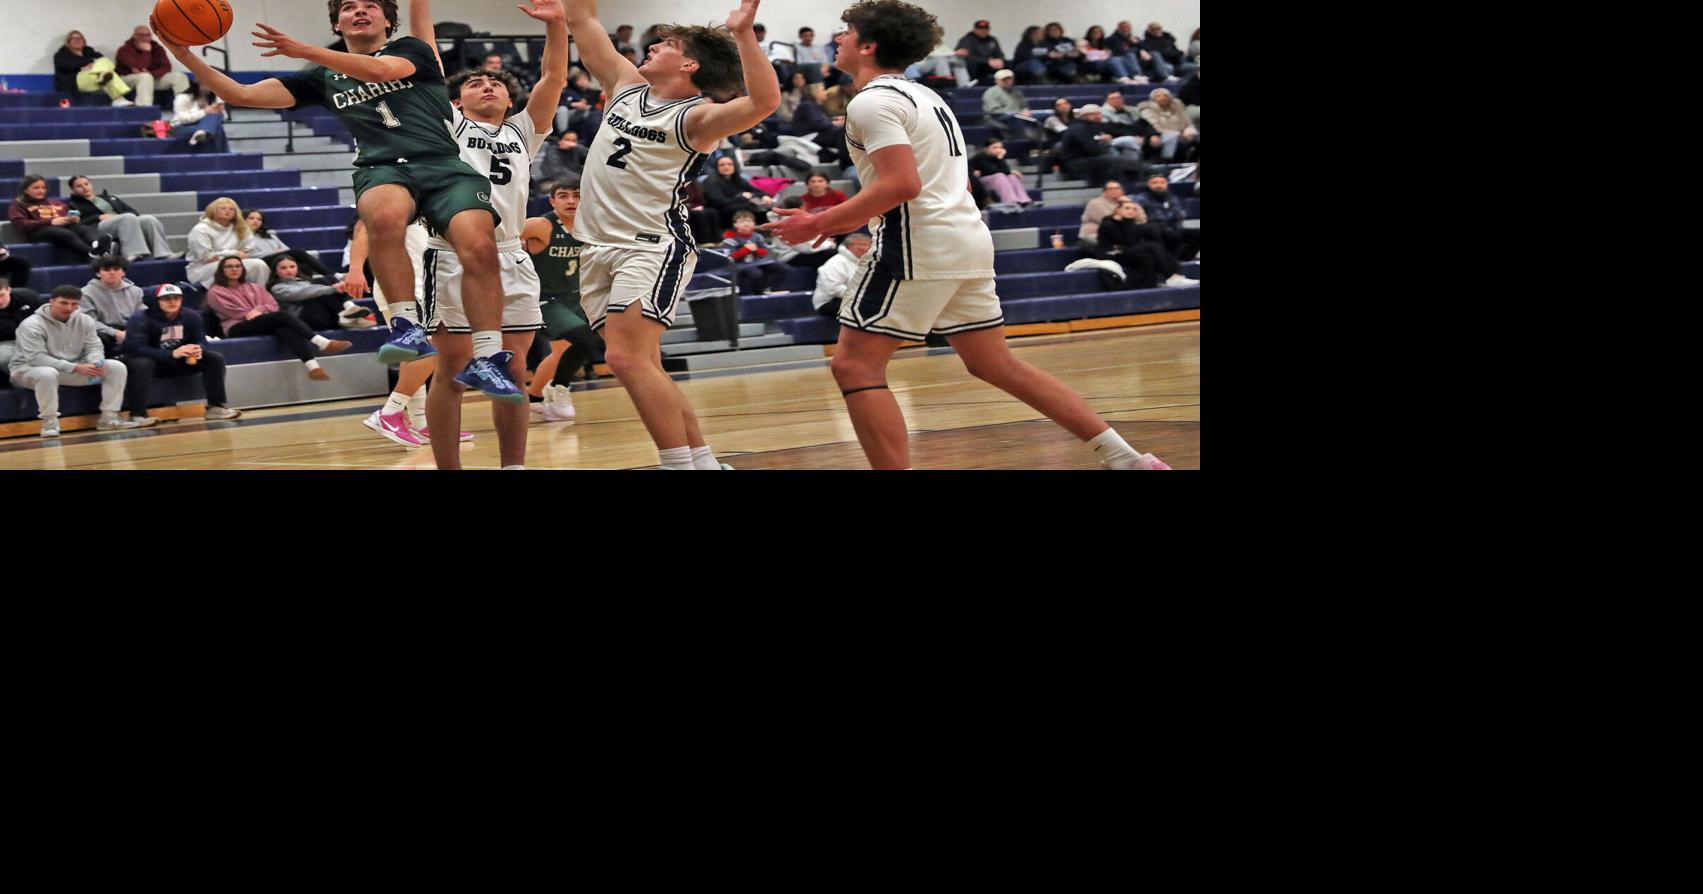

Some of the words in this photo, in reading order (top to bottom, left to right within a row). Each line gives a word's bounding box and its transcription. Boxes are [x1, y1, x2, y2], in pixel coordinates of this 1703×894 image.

[375, 100, 402, 129] 1
[605, 136, 633, 170] 2
[488, 154, 513, 186] 5
